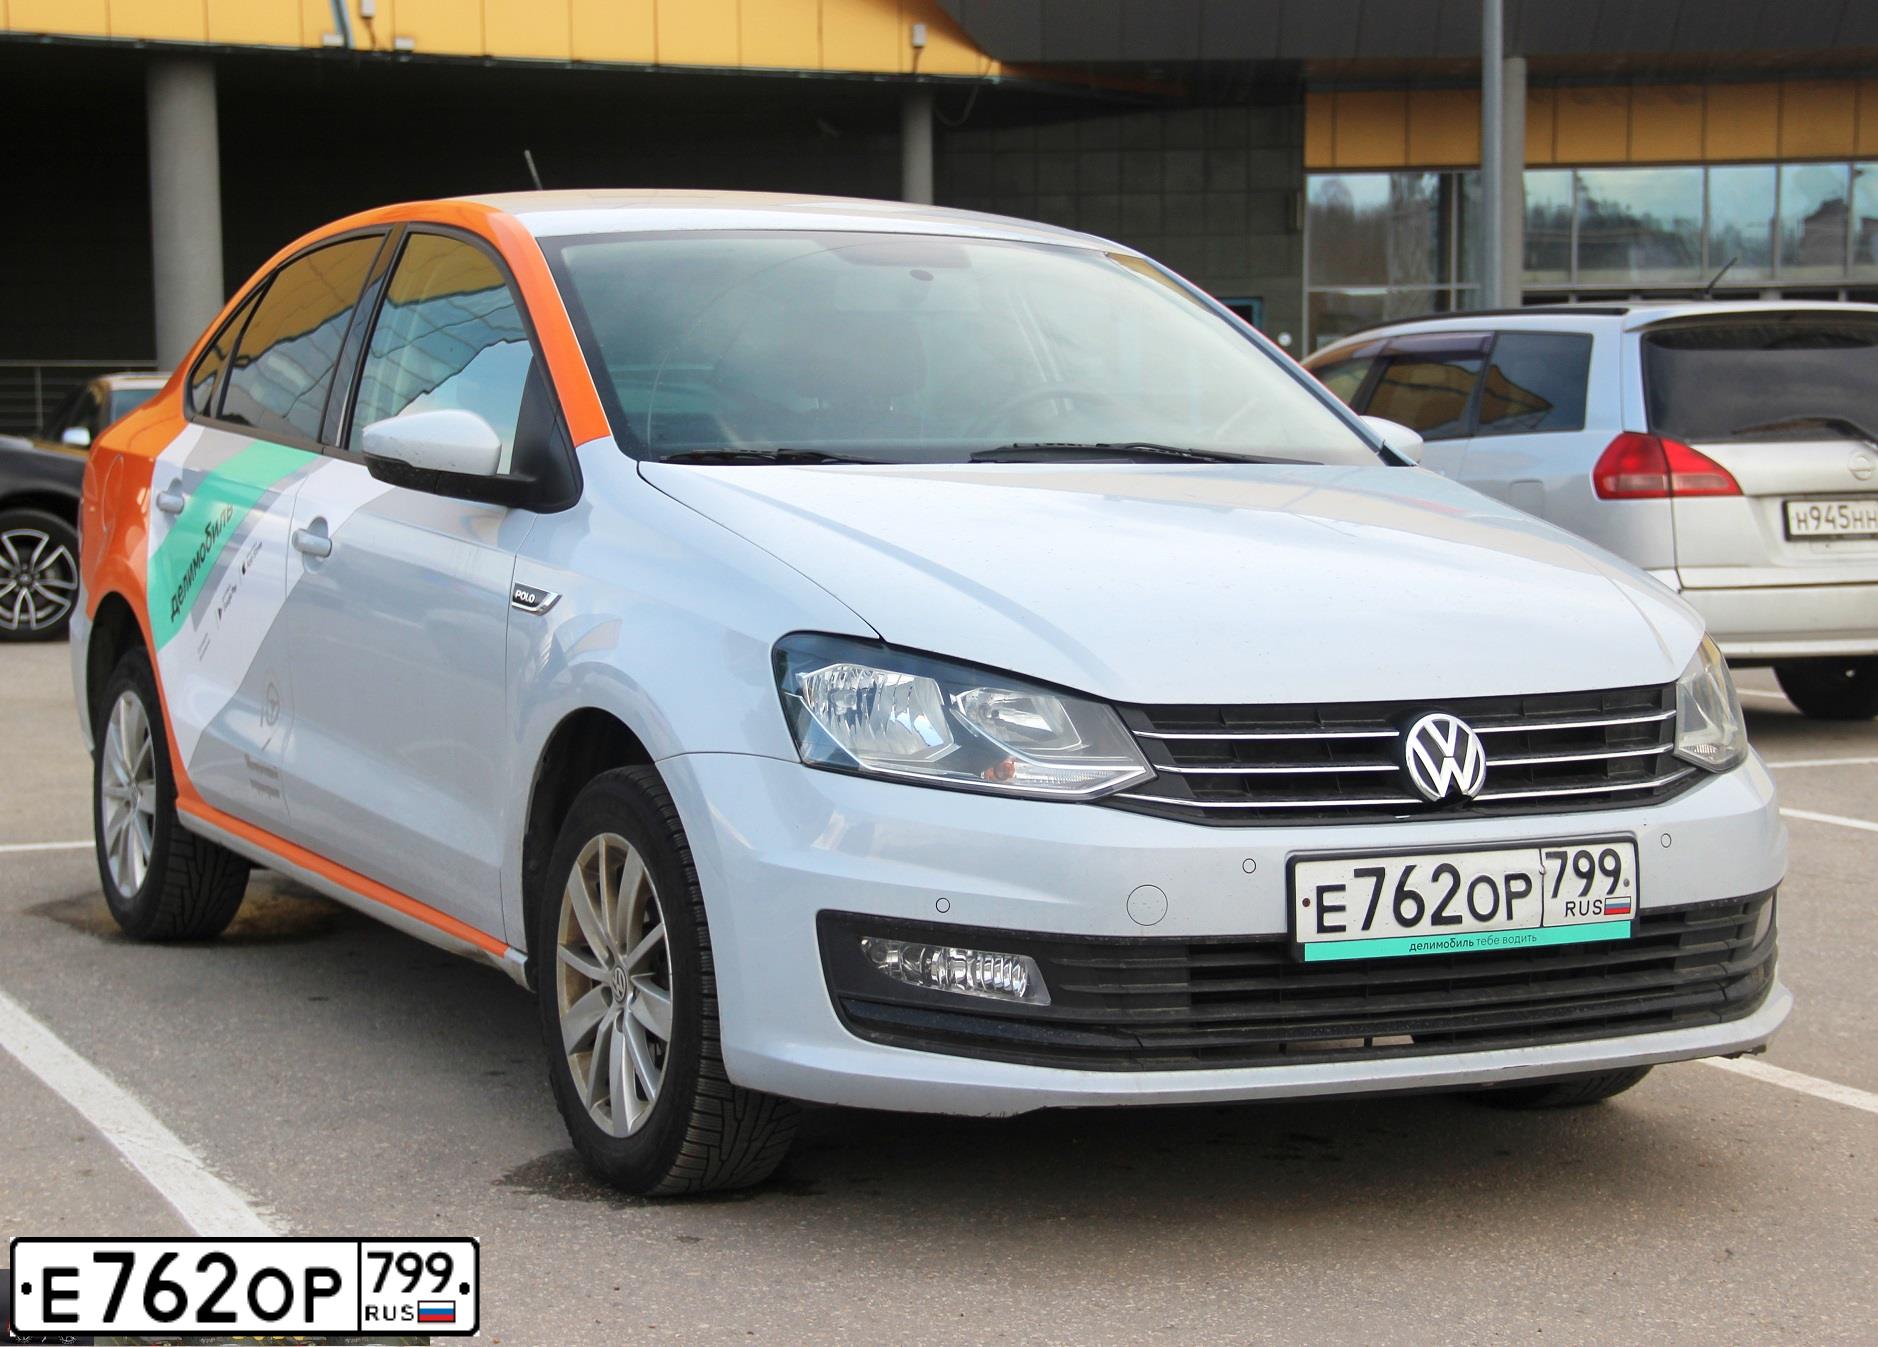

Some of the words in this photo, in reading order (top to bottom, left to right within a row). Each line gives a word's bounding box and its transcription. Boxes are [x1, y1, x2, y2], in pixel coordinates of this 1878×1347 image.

[170, 504, 233, 622] делимобиль
[515, 590, 535, 603] POLO
[1545, 848, 1622, 898] 799
[1564, 899, 1603, 918] RUS
[1409, 938, 1474, 952] делимобиль
[1476, 935, 1500, 946] тебе
[1502, 934, 1537, 945] водить
